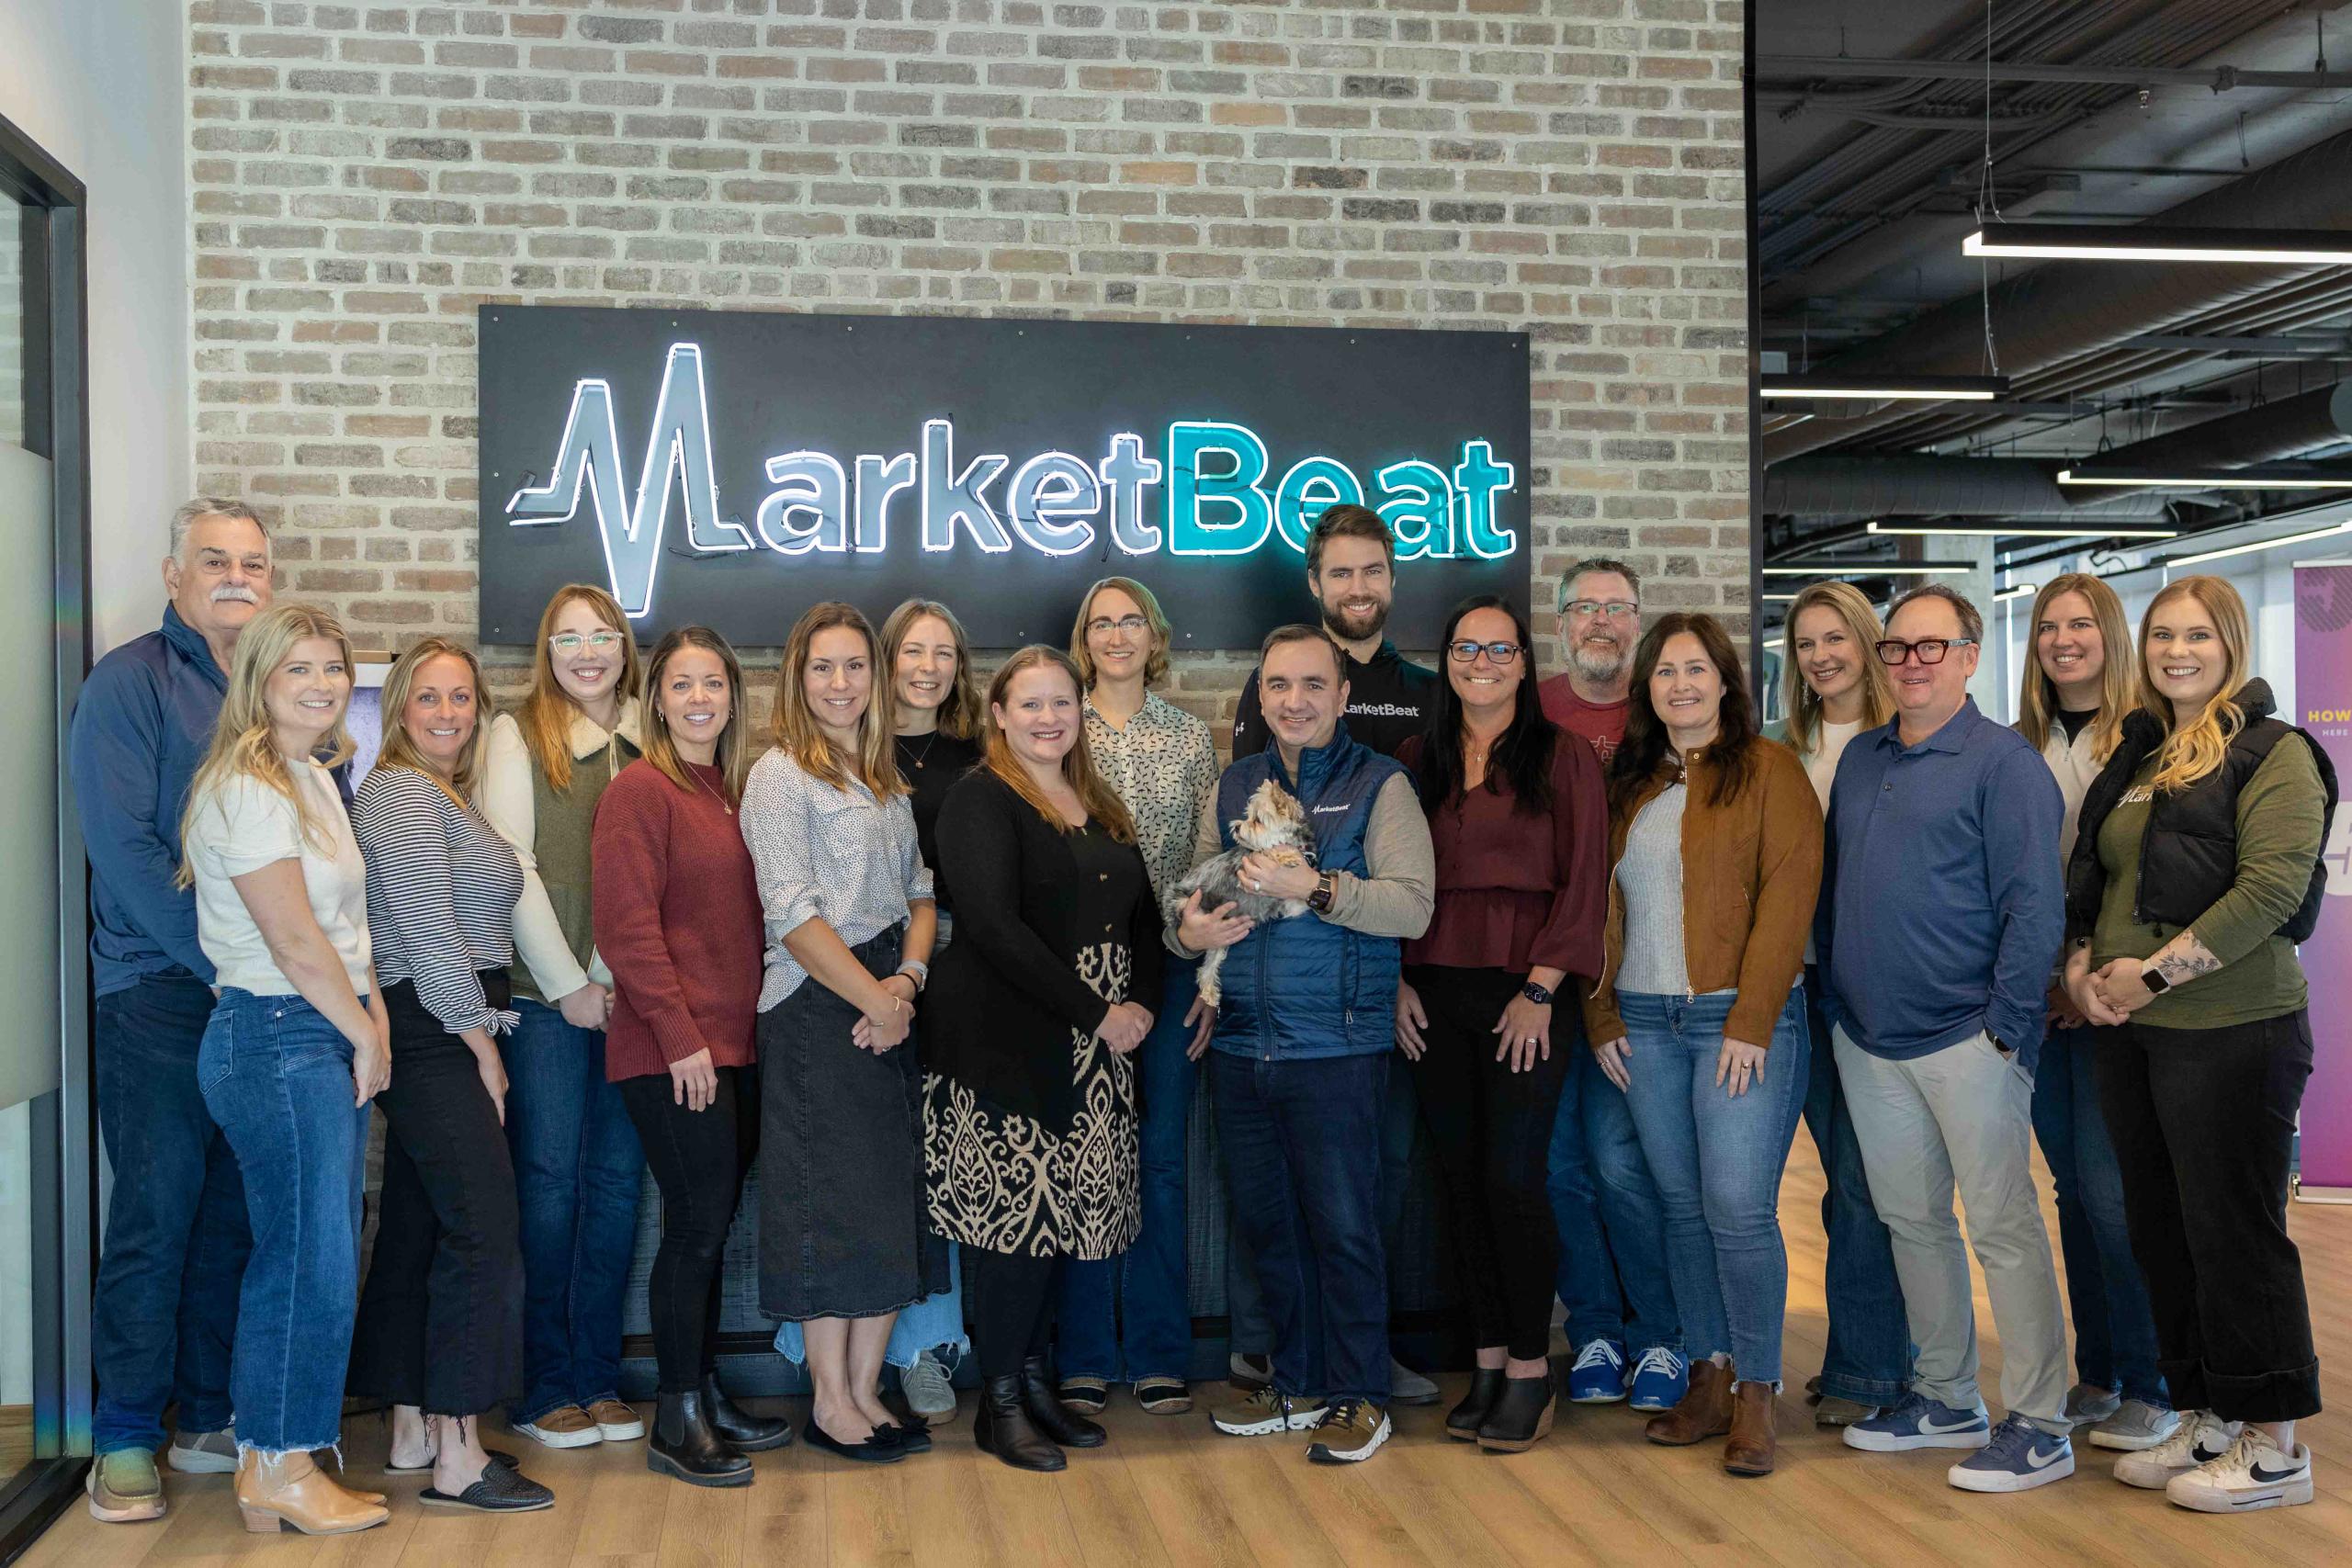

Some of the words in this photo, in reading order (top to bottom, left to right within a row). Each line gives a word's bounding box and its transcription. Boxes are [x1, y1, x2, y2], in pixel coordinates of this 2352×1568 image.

[505, 343, 1516, 618] MarketBeat
[2308, 709, 2351, 723] HOW
[2322, 728, 2348, 737] HERE
